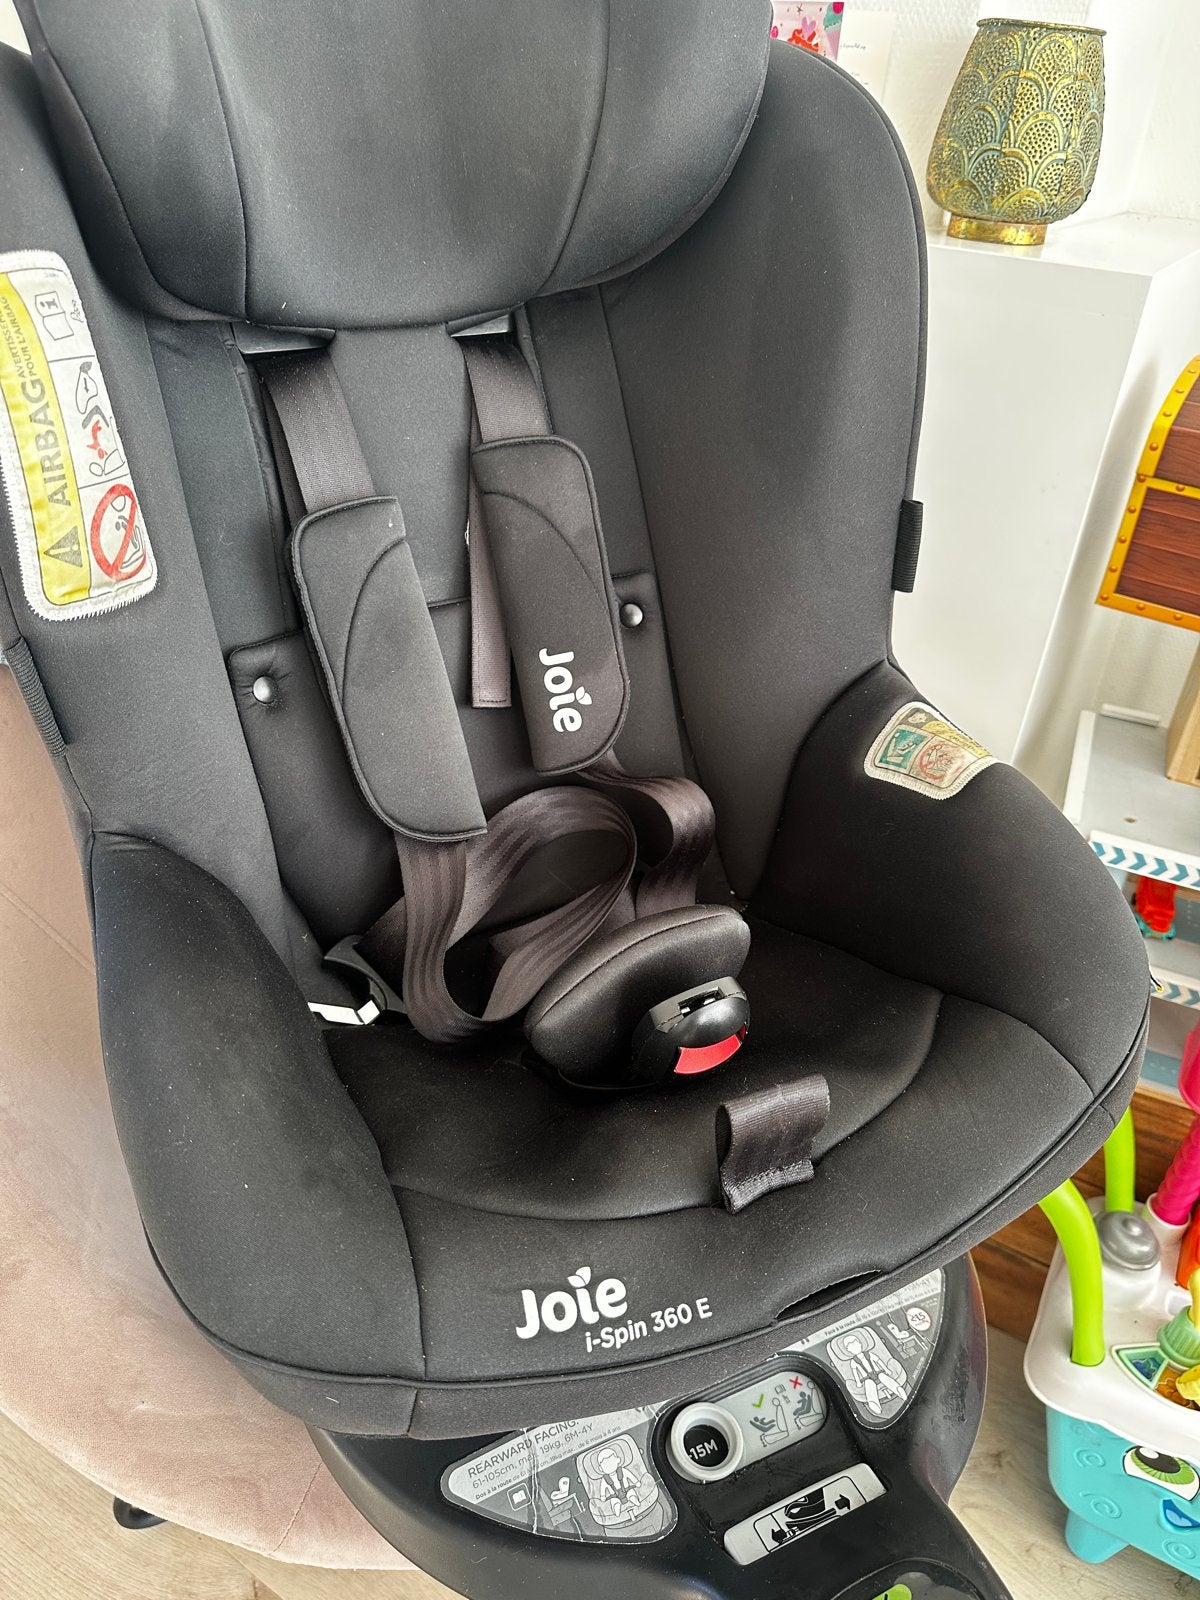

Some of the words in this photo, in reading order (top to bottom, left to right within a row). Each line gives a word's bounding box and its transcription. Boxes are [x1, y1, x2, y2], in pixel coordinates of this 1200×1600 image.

[0, 309, 26, 379] AVERTISSEM
[1, 297, 26, 344] L'AIRBAG
[21, 346, 37, 377] POUR
[21, 377, 72, 507] AIRBAG
[538, 647, 593, 733] Joie
[515, 1266, 628, 1339] Joie
[585, 1319, 648, 1353] i-Spin
[650, 1303, 693, 1333] 360
[695, 1297, 713, 1320] E
[564, 1422, 594, 1443] 6M-4Y
[467, 1439, 533, 1478] REARWARD
[475, 1490, 487, 1500] Dos
